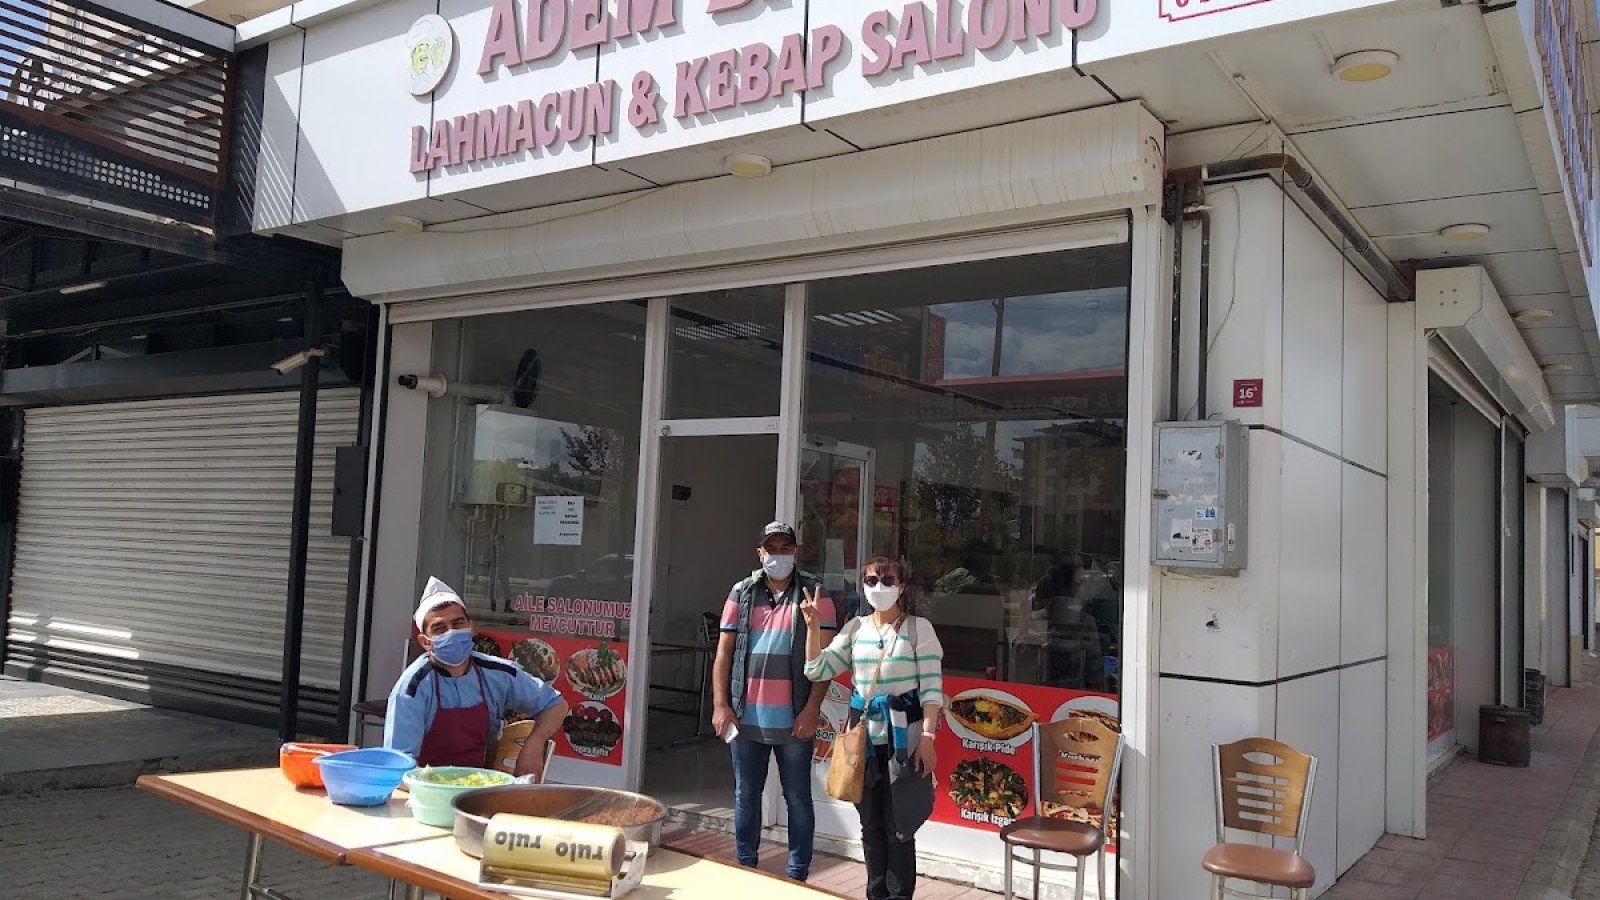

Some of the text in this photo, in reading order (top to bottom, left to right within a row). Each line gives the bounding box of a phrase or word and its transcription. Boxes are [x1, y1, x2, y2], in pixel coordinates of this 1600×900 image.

[409, 79, 616, 173] LAHMACUN
[628, 71, 659, 128] &
[674, 24, 842, 119] KEBAP
[514, 592, 632, 621] AİLE SALONUMUZ
[530, 614, 616, 638] MEVCUTTUR
[991, 813, 1016, 828] Izgar
[495, 831, 604, 862] rulo rulo
